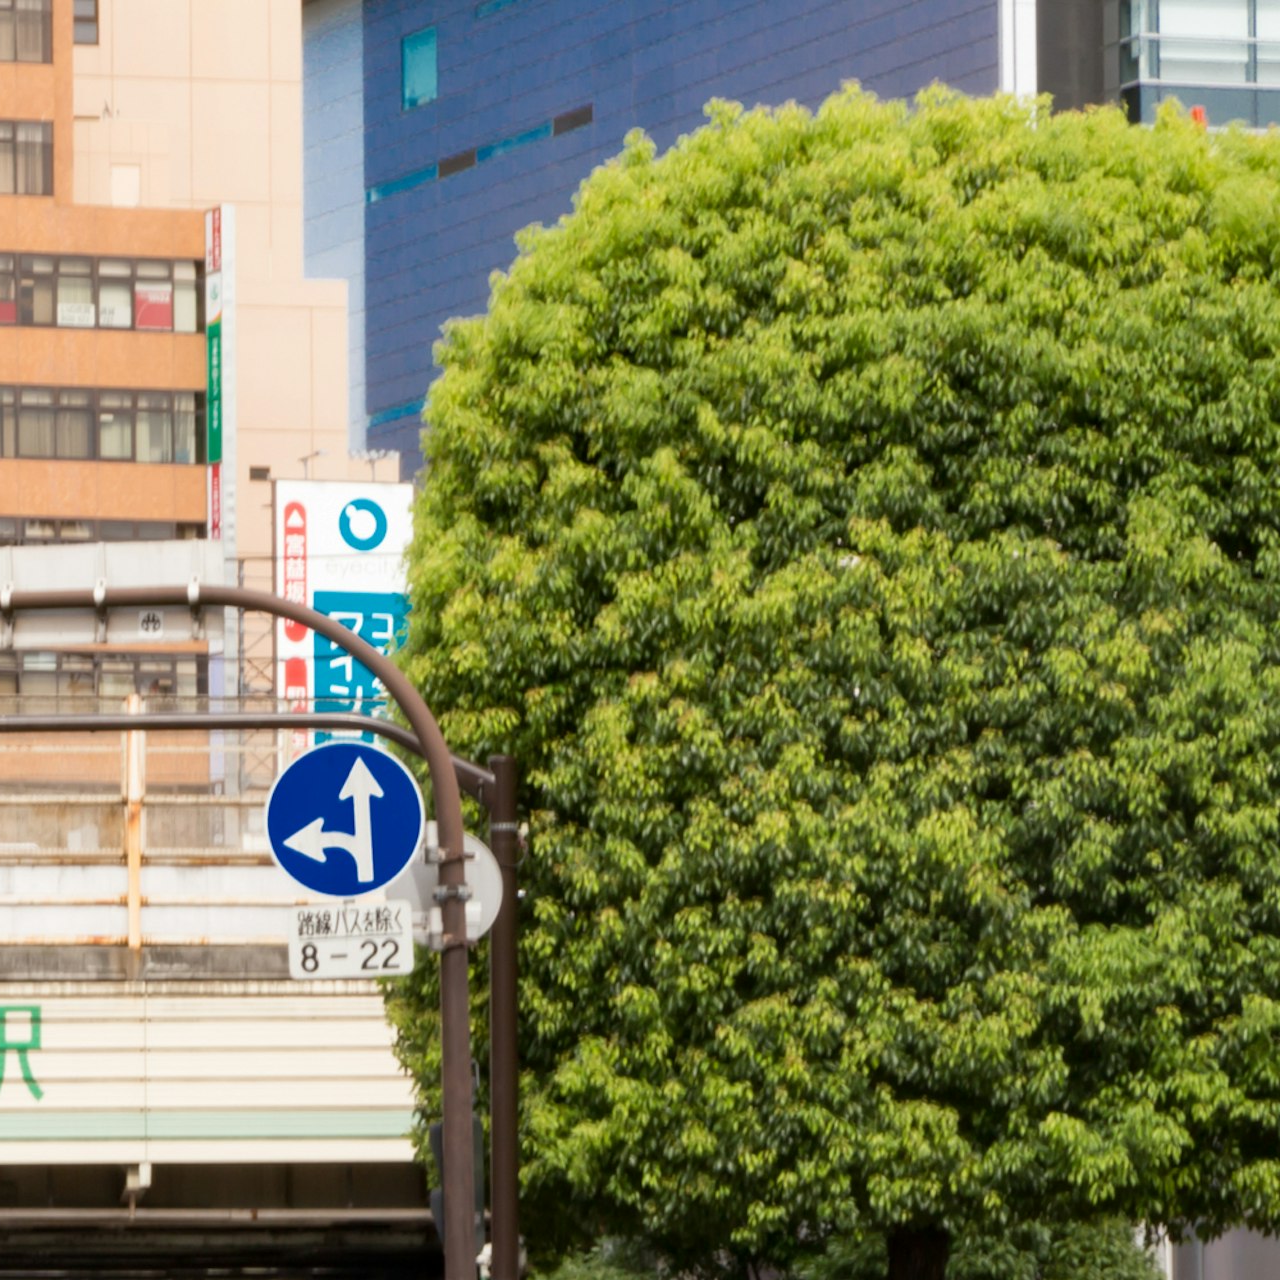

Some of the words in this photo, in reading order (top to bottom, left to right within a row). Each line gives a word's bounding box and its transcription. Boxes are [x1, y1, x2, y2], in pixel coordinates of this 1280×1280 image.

[285, 534, 306, 628] 宮益坂
[297, 907, 403, 936] 路線バスを除く
[301, 942, 319, 972] 8
[361, 939, 400, 970] 22
